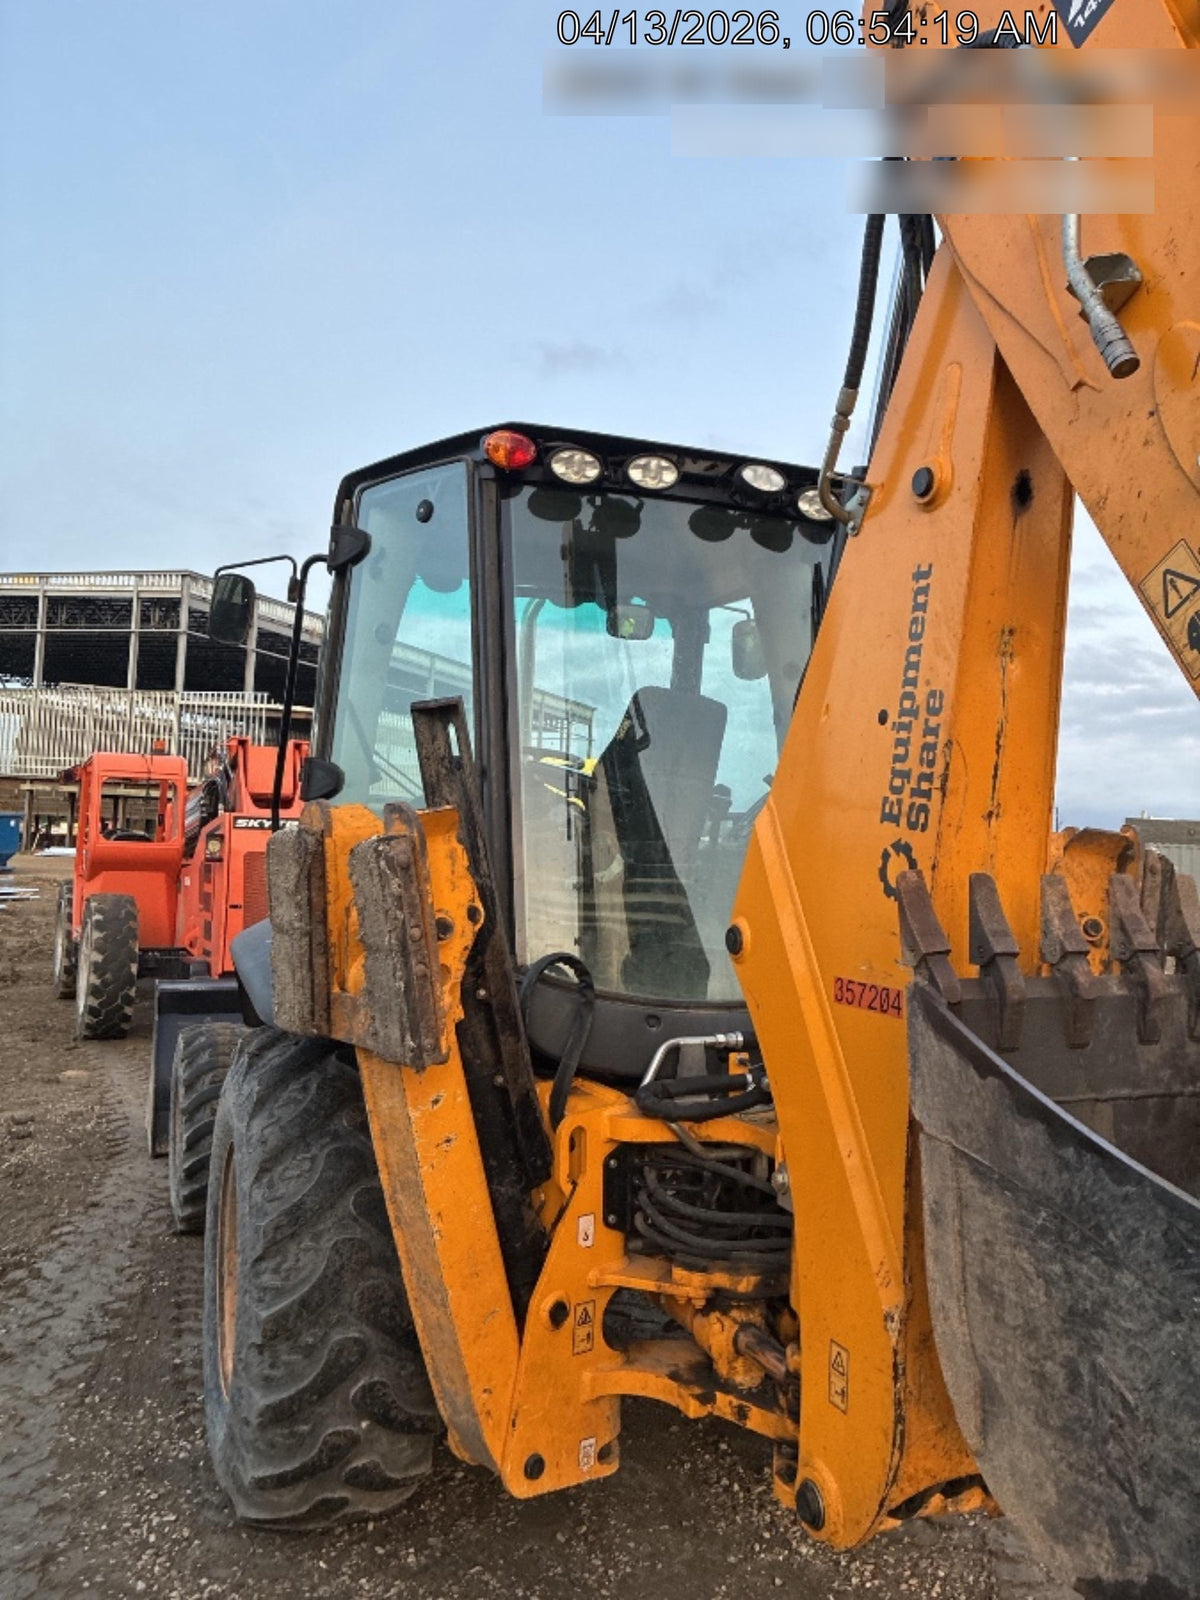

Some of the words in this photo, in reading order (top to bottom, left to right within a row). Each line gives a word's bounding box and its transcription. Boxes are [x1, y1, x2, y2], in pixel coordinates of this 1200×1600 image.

[1073, 0, 1102, 28] 14
[880, 563, 933, 828] Equipment
[906, 689, 945, 833] Share
[835, 977, 902, 1016] 357204
